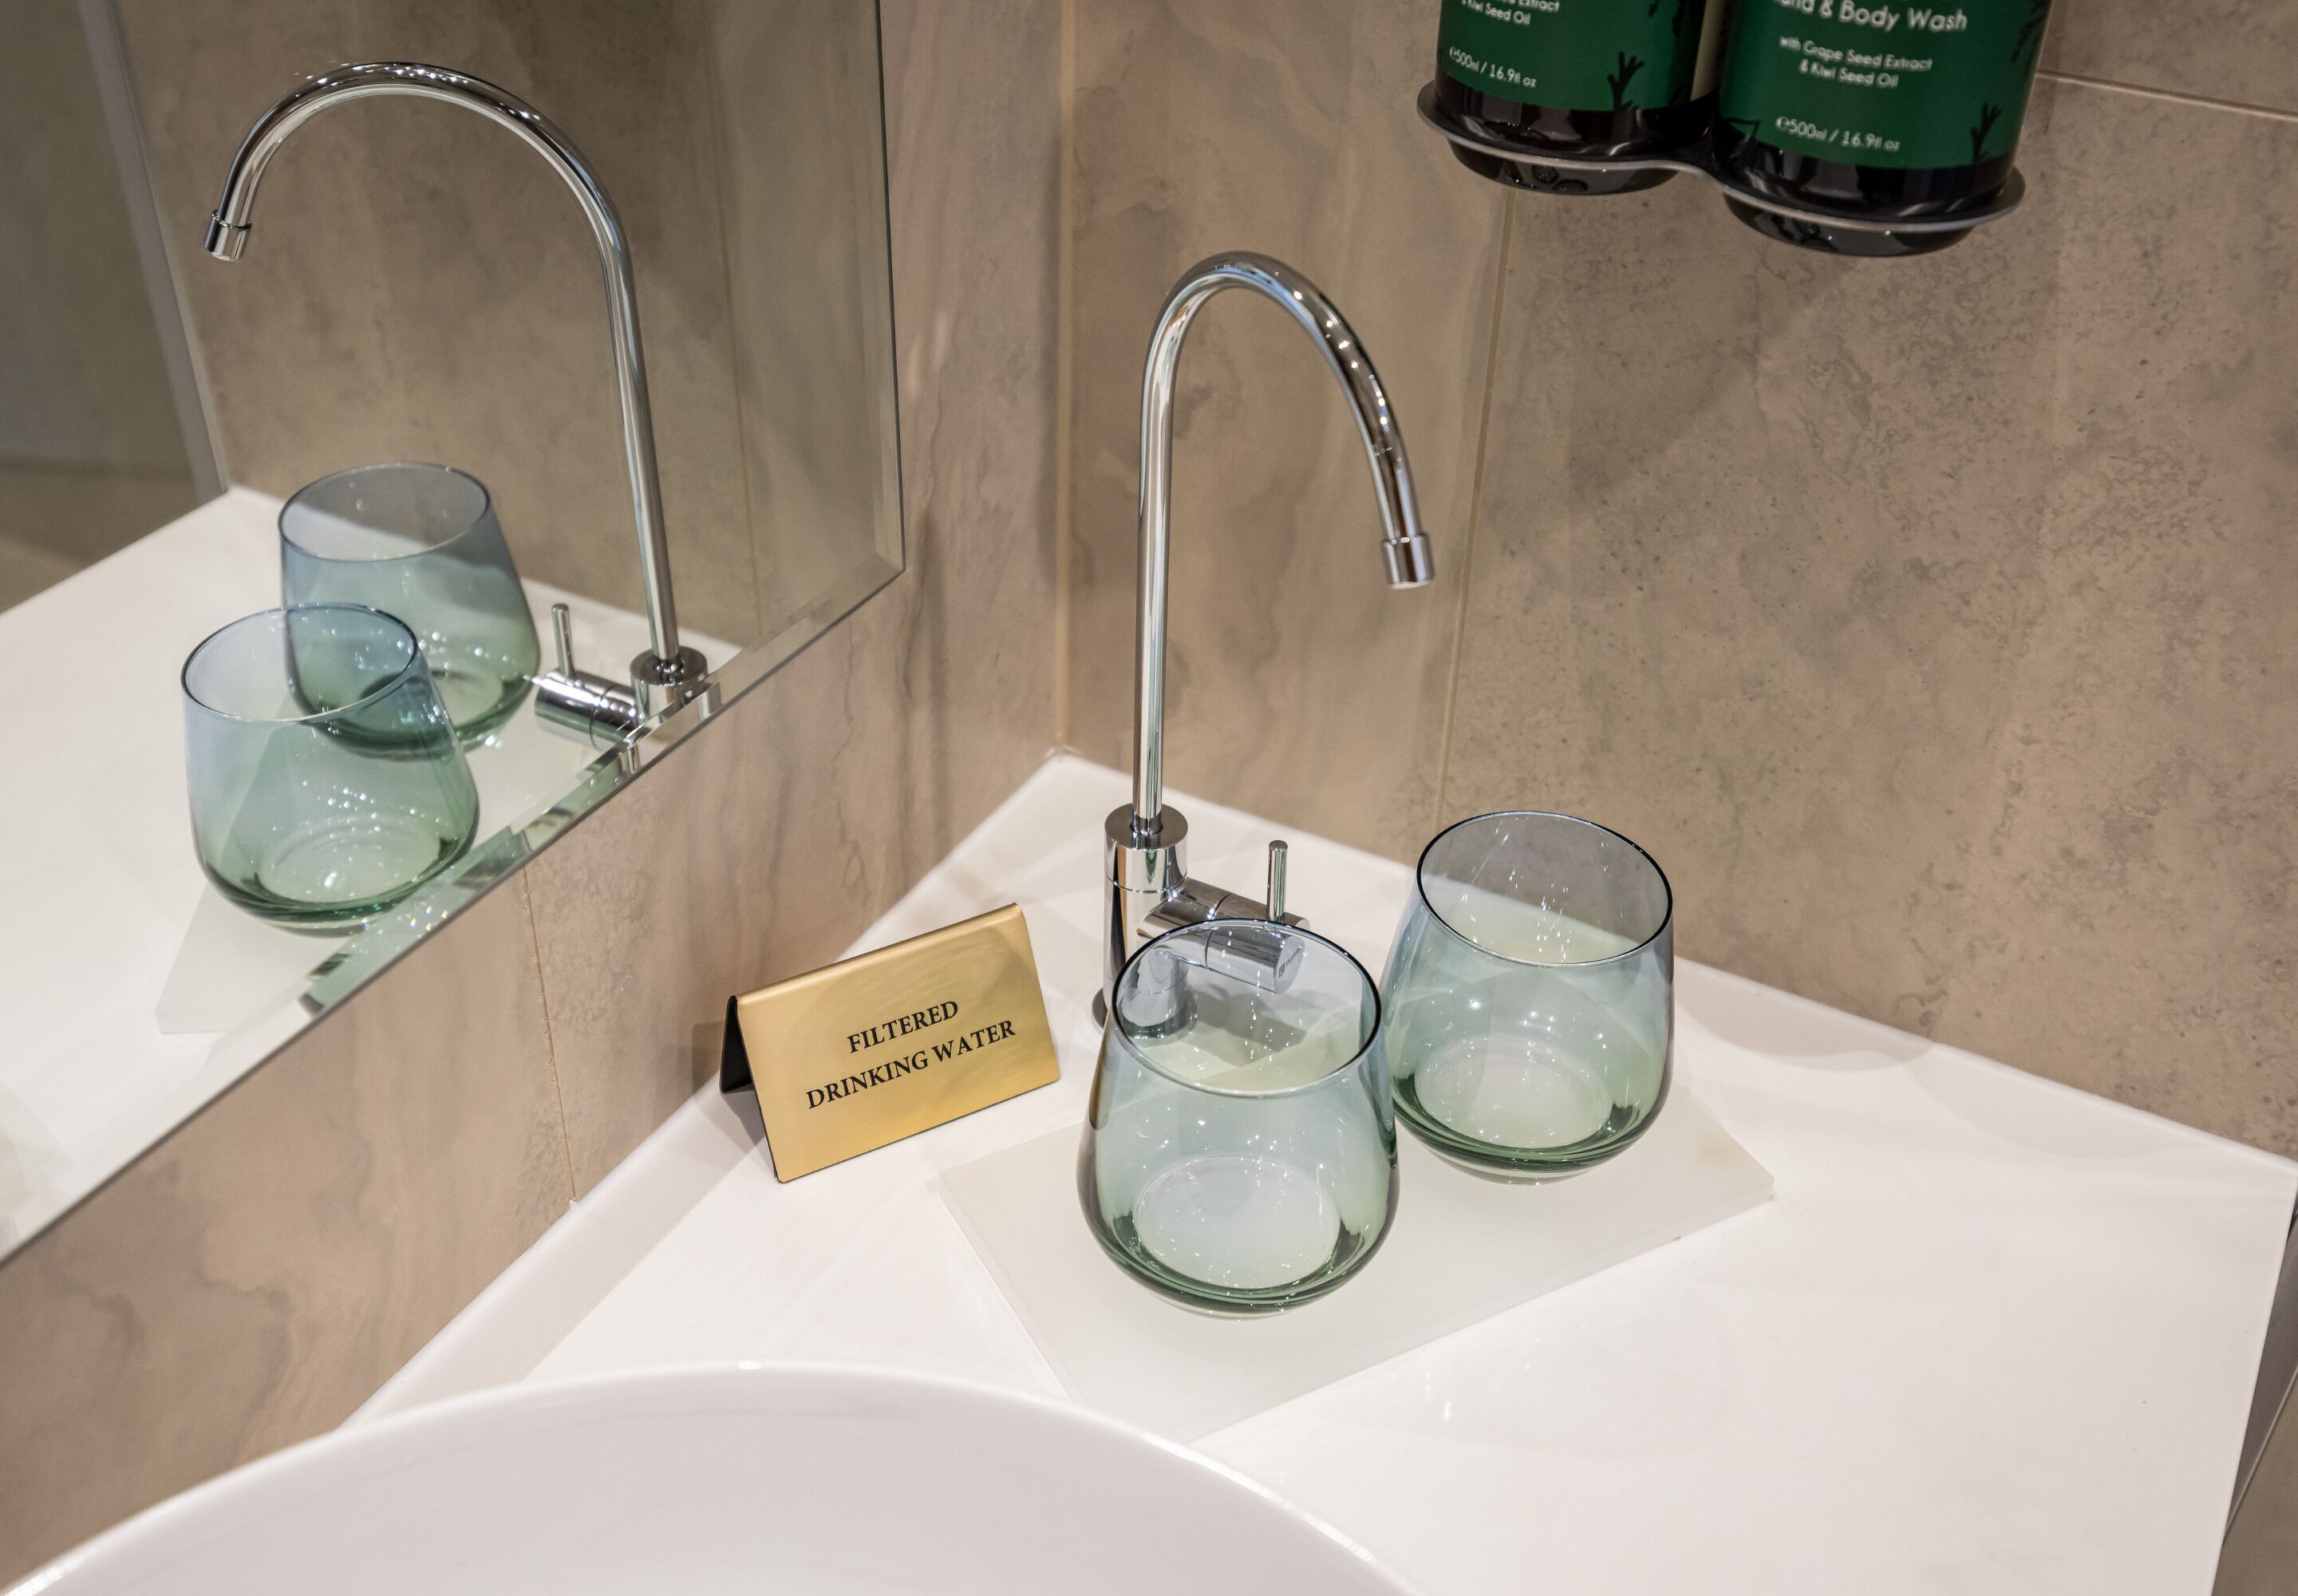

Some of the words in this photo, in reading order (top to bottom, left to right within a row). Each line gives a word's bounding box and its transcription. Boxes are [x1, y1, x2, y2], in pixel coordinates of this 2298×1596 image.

[1485, 2, 1511, 21] Seed
[1513, 10, 1530, 25] Oil
[1818, 0, 1833, 18] &
[1838, 0, 1900, 32] Body
[1908, 8, 1968, 32] Wash
[1780, 36, 1801, 51] with
[1804, 41, 1843, 61] Grape
[1847, 49, 1882, 68] Seed
[1885, 54, 1933, 71] Extract
[1522, 77, 1537, 89] oz
[1800, 59, 1809, 73] &
[1812, 61, 1836, 79] Kiwi
[1839, 67, 1874, 85] Seed
[1878, 73, 1899, 88] Oil
[1885, 140, 1901, 152] oz
[847, 1000, 958, 1053] FILTERED
[805, 1051, 928, 1109] DRINKING
[932, 1020, 1016, 1063] WATER
